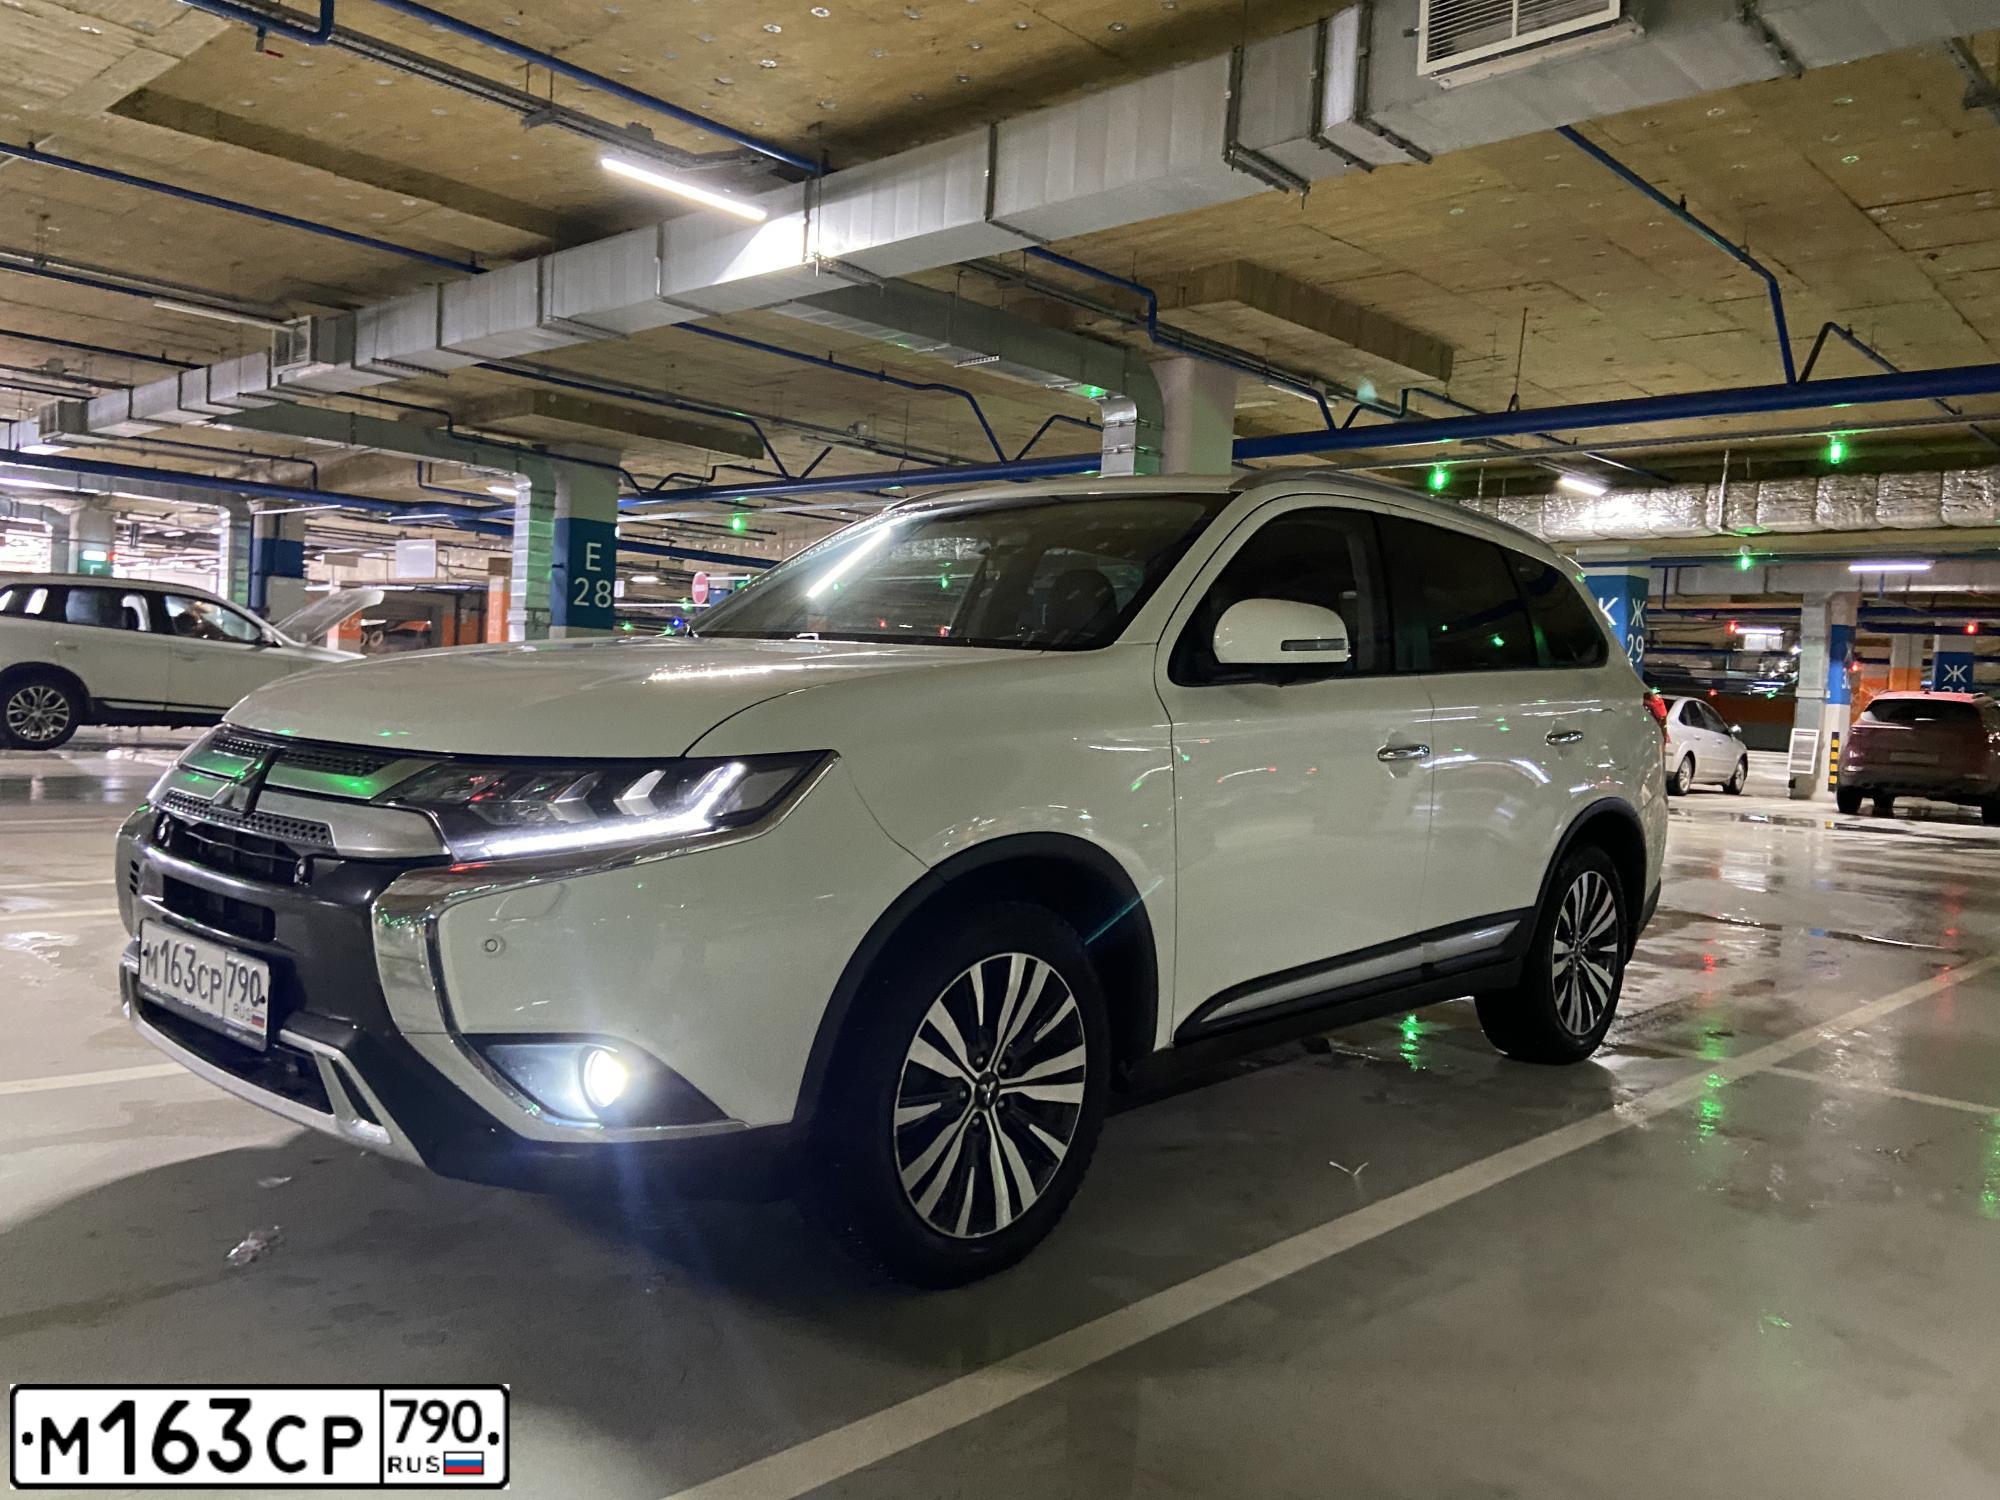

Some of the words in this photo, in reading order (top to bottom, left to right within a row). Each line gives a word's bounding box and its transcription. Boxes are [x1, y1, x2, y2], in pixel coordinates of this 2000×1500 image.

[572, 576, 613, 609] 28
[1630, 598, 1647, 629] Ж
[1626, 633, 1646, 664] 29
[1942, 663, 1969, 683] Ж
[226, 960, 263, 1008] 790
